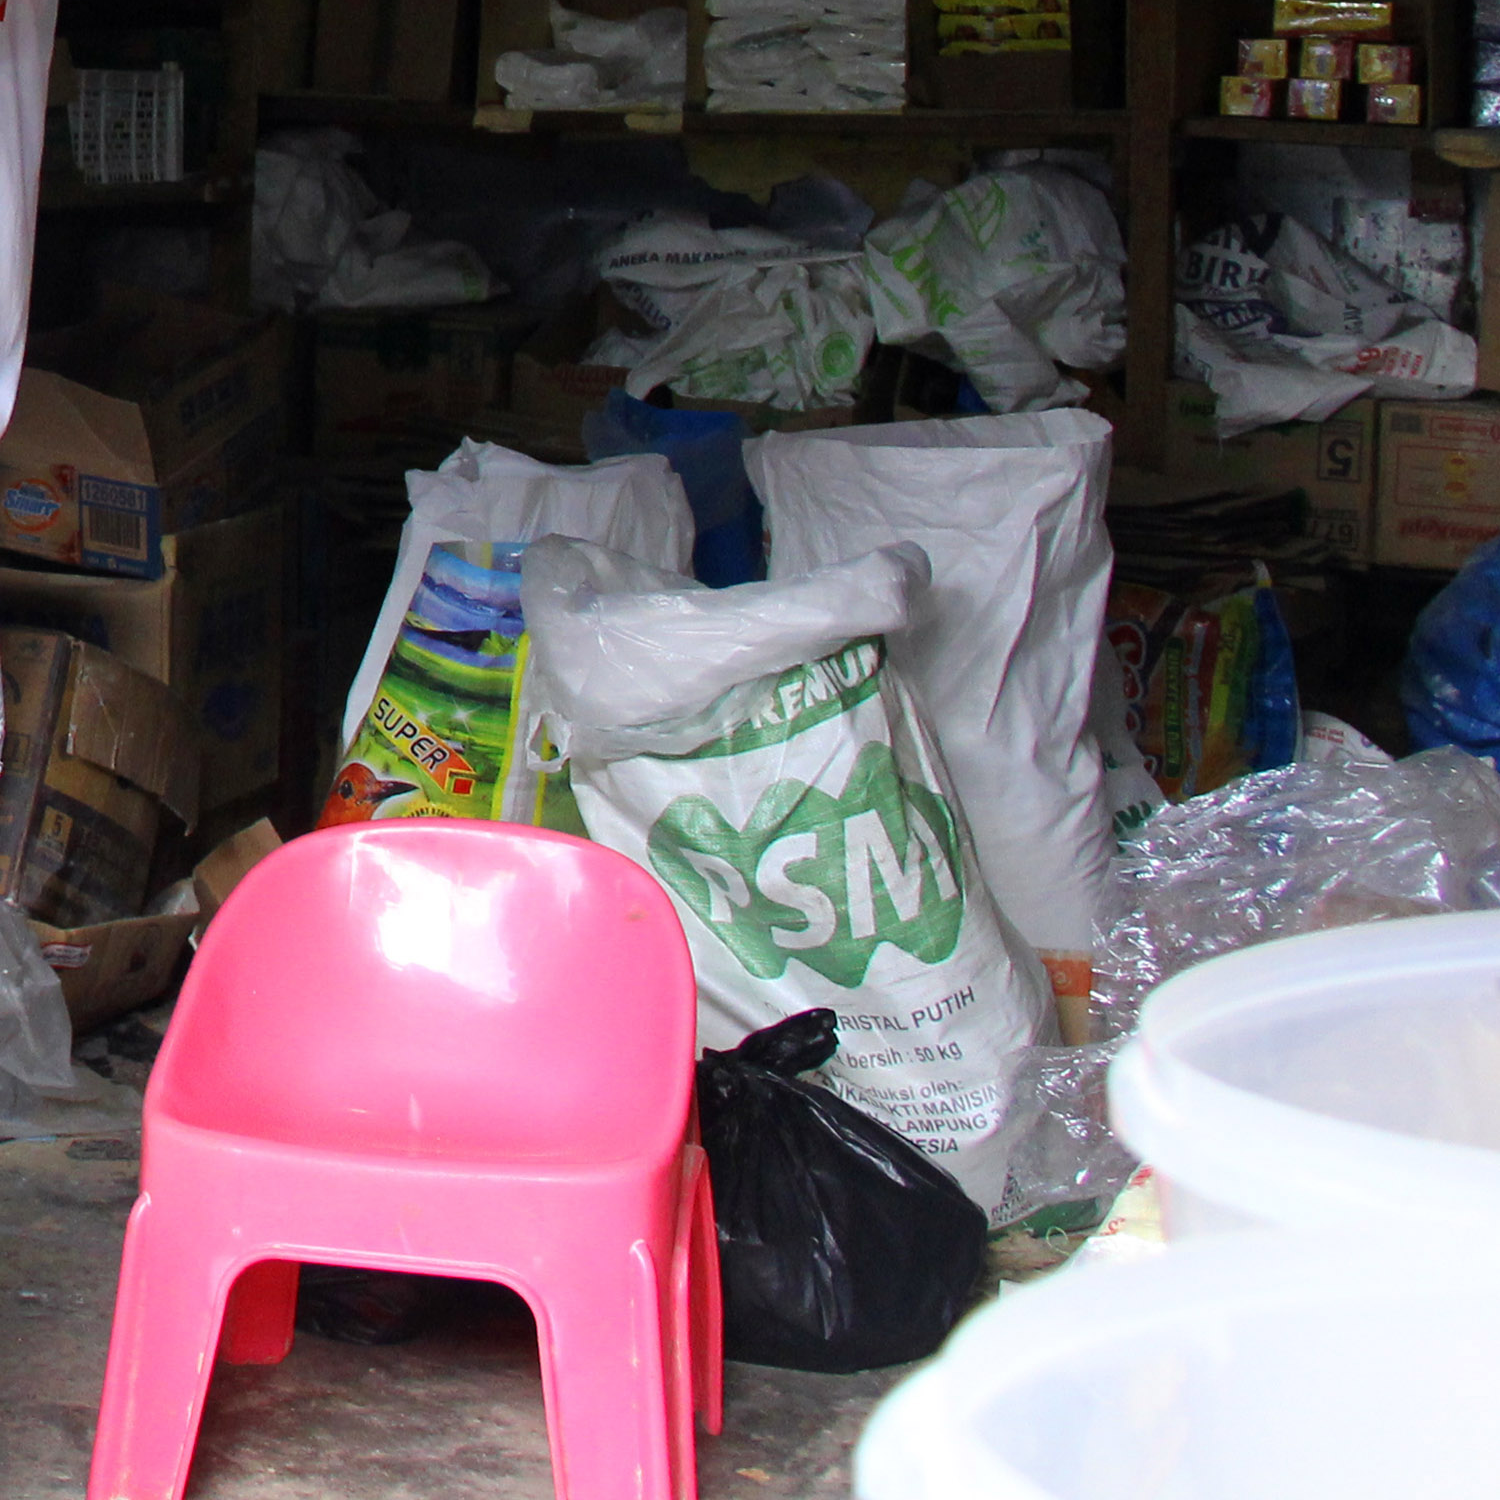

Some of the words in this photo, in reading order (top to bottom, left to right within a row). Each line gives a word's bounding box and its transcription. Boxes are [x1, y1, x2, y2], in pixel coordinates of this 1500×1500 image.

[610, 252, 659, 269] ANEKA
[371, 697, 451, 772] SUPER
[837, 1015, 907, 1032] RISTAL
[911, 985, 975, 1027] PUTIH
[849, 1050, 901, 1069] bersih
[915, 1046, 934, 1062] 50
[939, 1041, 963, 1061] kg
[893, 1112, 988, 1133] LAMPUNG
